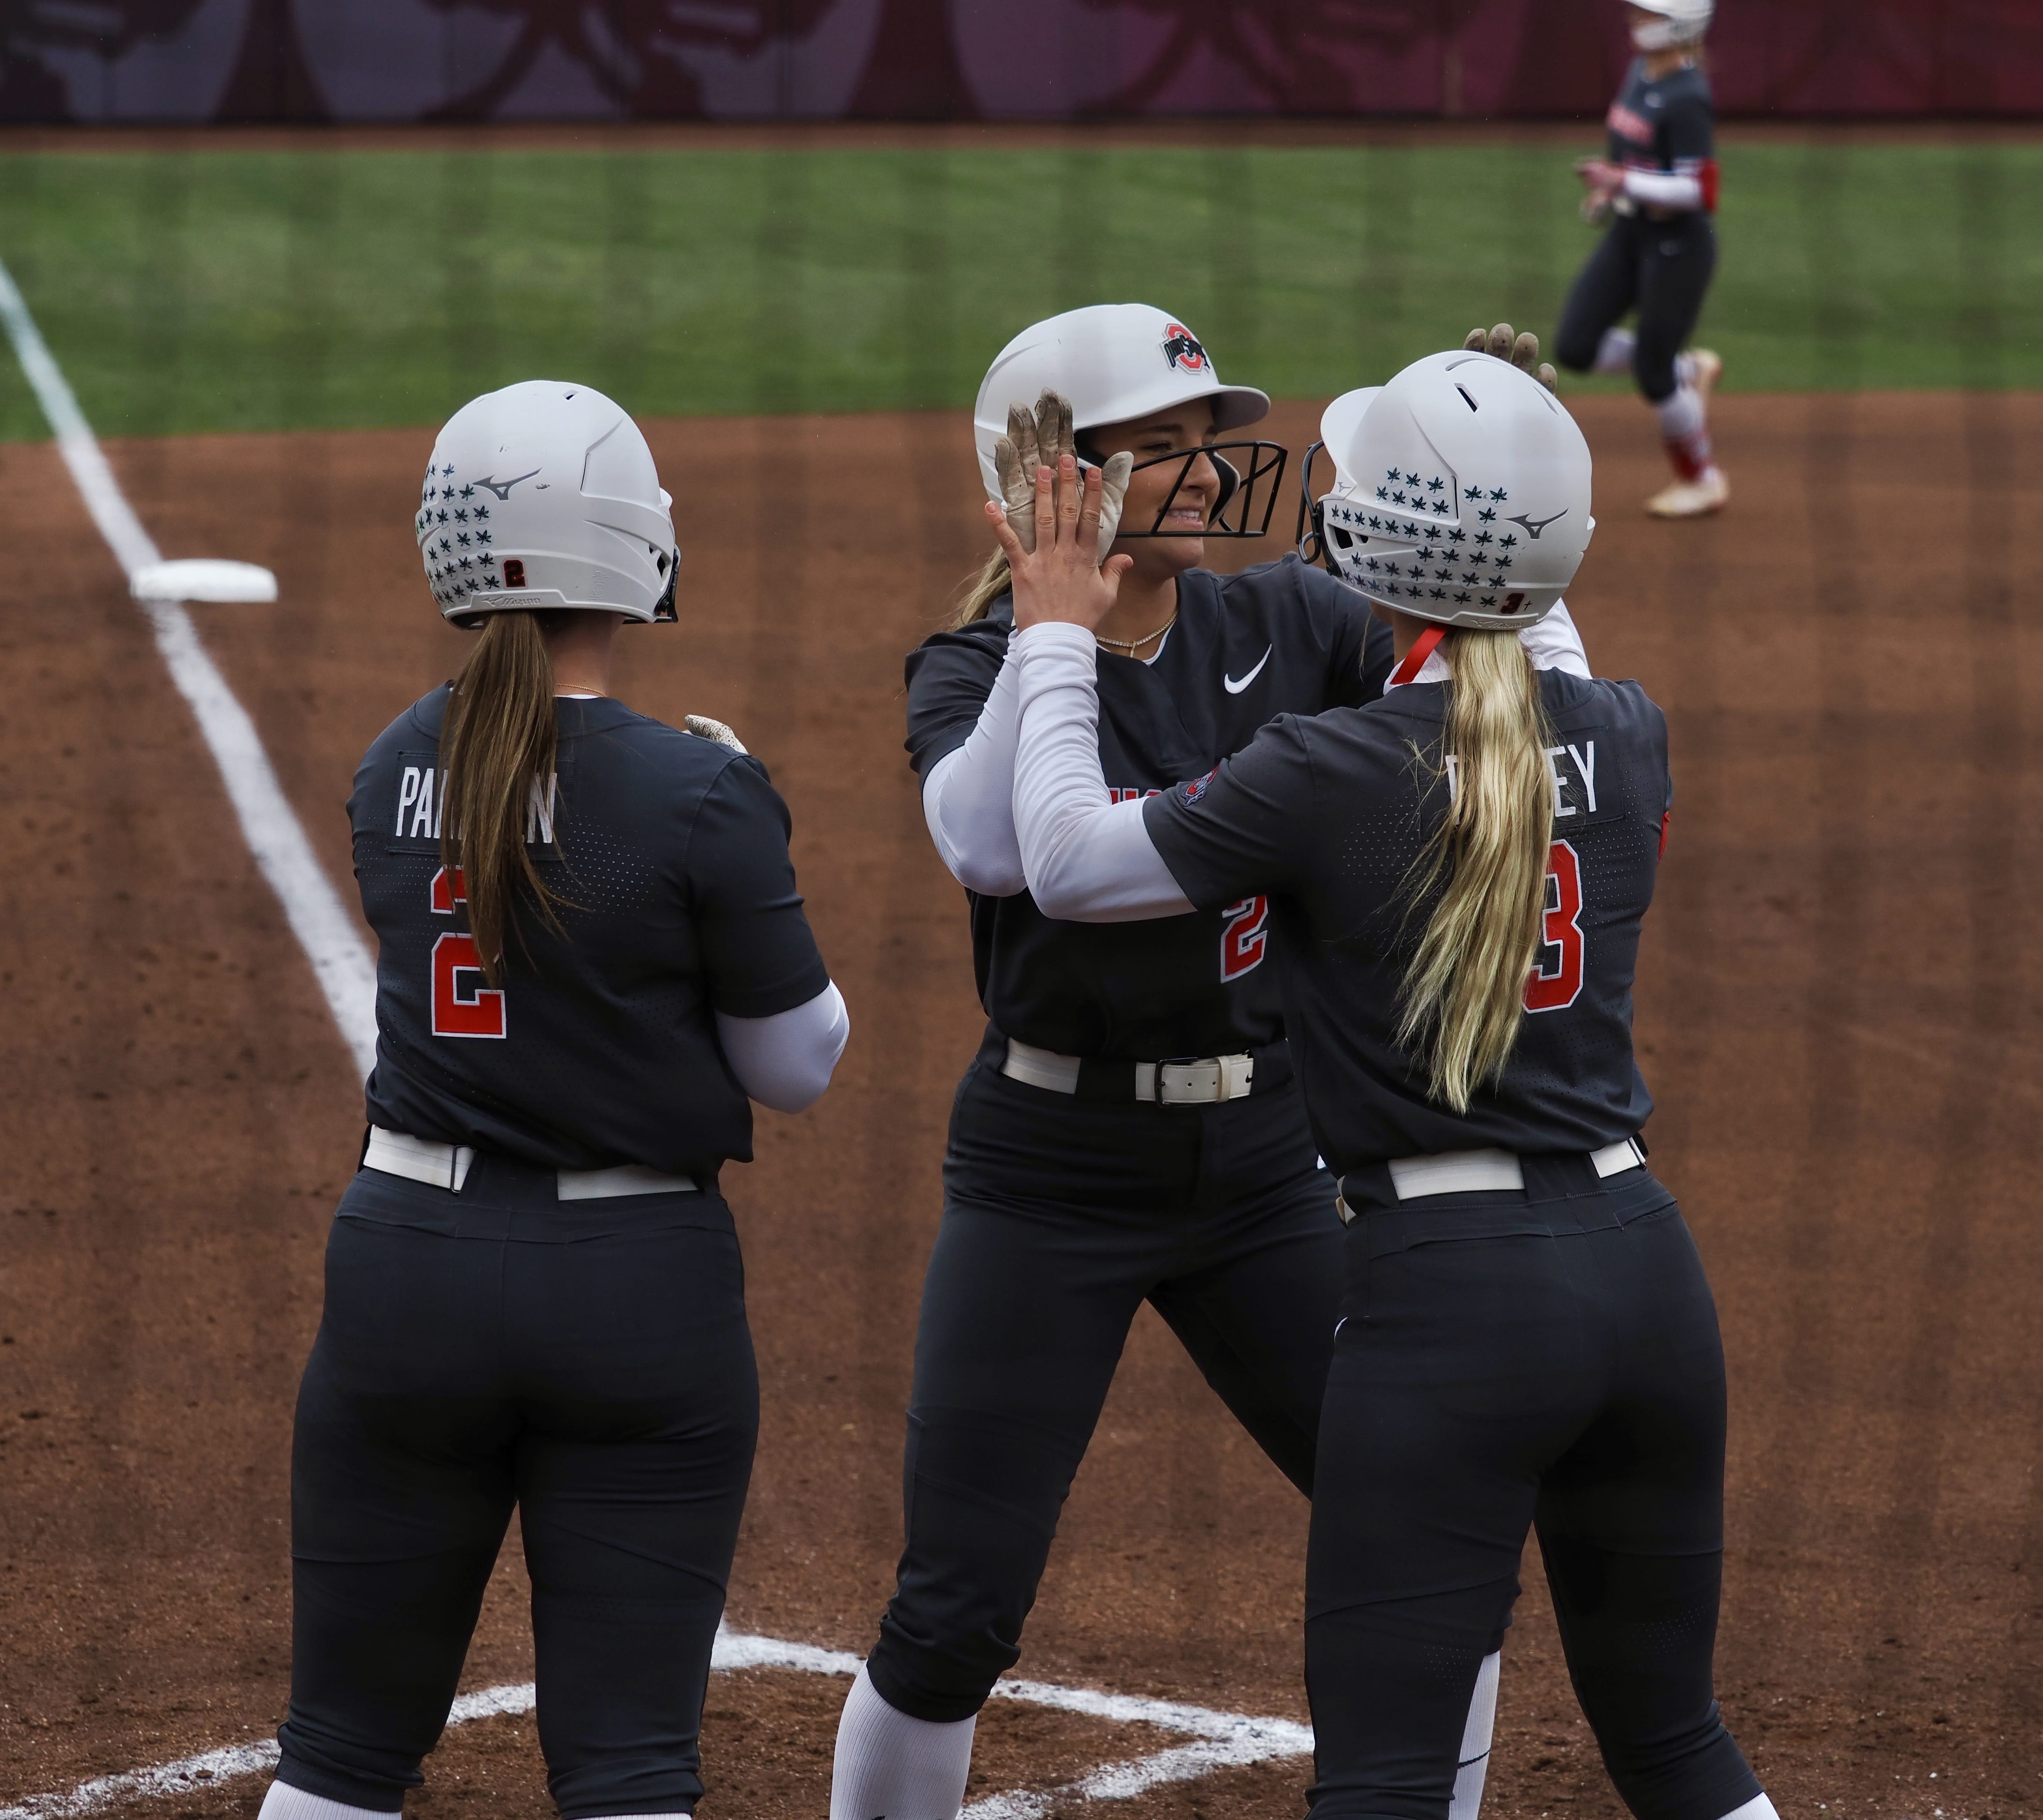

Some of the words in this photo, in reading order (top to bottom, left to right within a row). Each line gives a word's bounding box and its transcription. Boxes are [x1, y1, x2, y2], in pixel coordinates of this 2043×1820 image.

[503, 560, 526, 587] 2
[1499, 593, 1525, 614] 3
[431, 864, 507, 1039] 2
[1220, 895, 1268, 983] 2
[1522, 838, 1584, 1014] 3
